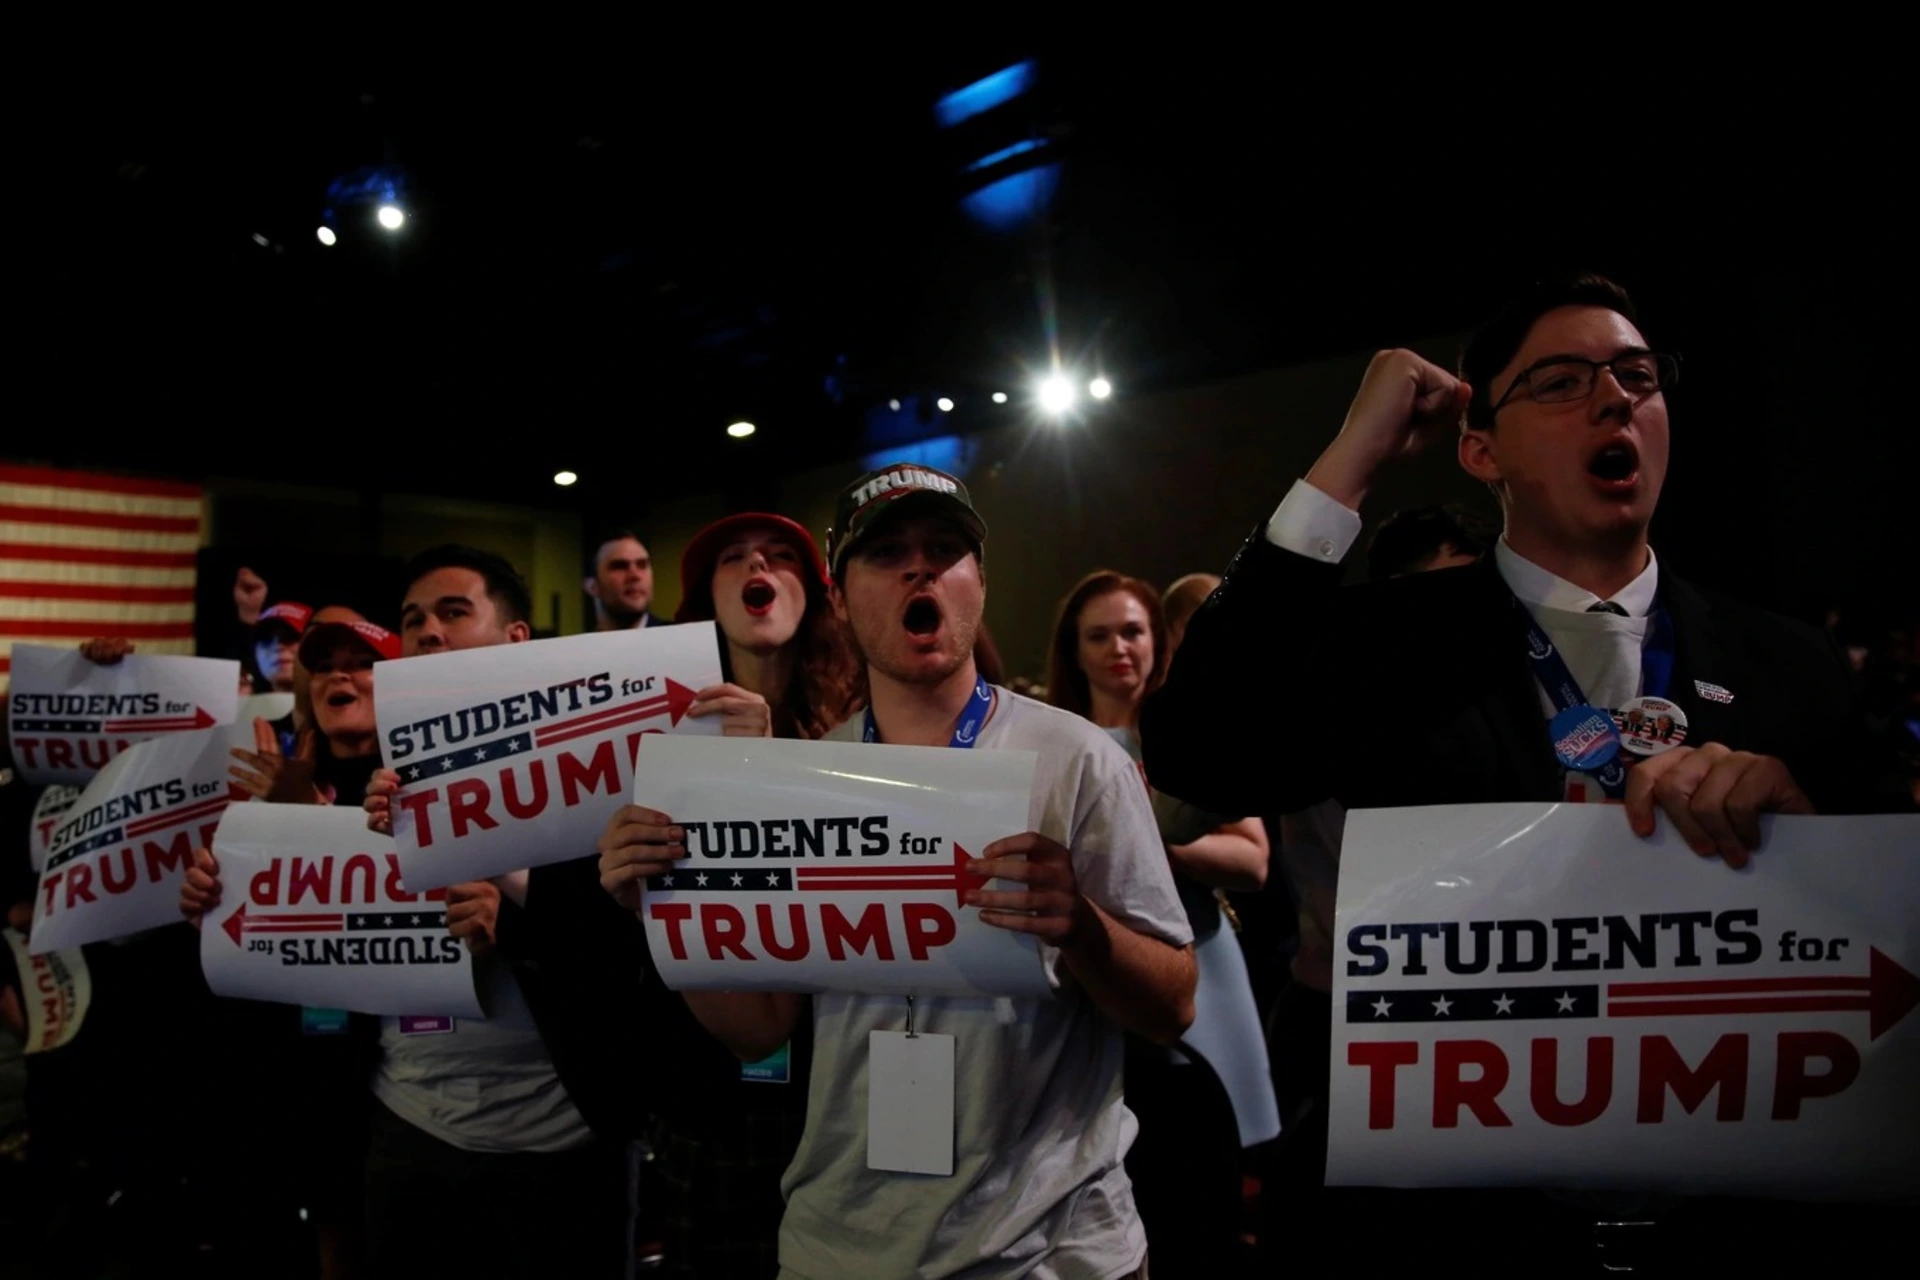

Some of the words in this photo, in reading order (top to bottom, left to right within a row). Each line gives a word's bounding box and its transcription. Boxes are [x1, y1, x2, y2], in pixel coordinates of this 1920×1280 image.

[851, 469, 957, 507] TRUMP
[12, 694, 159, 715] STUDENTS
[165, 702, 190, 713] for
[389, 672, 614, 760] STUDENTS
[621, 676, 655, 696] for
[1562, 722, 1609, 760] SUCKS
[51, 779, 186, 851] STUDENTS
[192, 781, 219, 797] for
[681, 816, 889, 860] TUDENTS
[900, 832, 942, 855] for
[250, 854, 448, 905] RUMP
[248, 940, 273, 954] for
[280, 937, 461, 965] STUDENTS
[651, 903, 957, 961] TRUMP
[1346, 909, 1762, 976] STUDENTS
[1779, 931, 1849, 962] for
[1348, 1032, 1861, 1130] TRUMP
